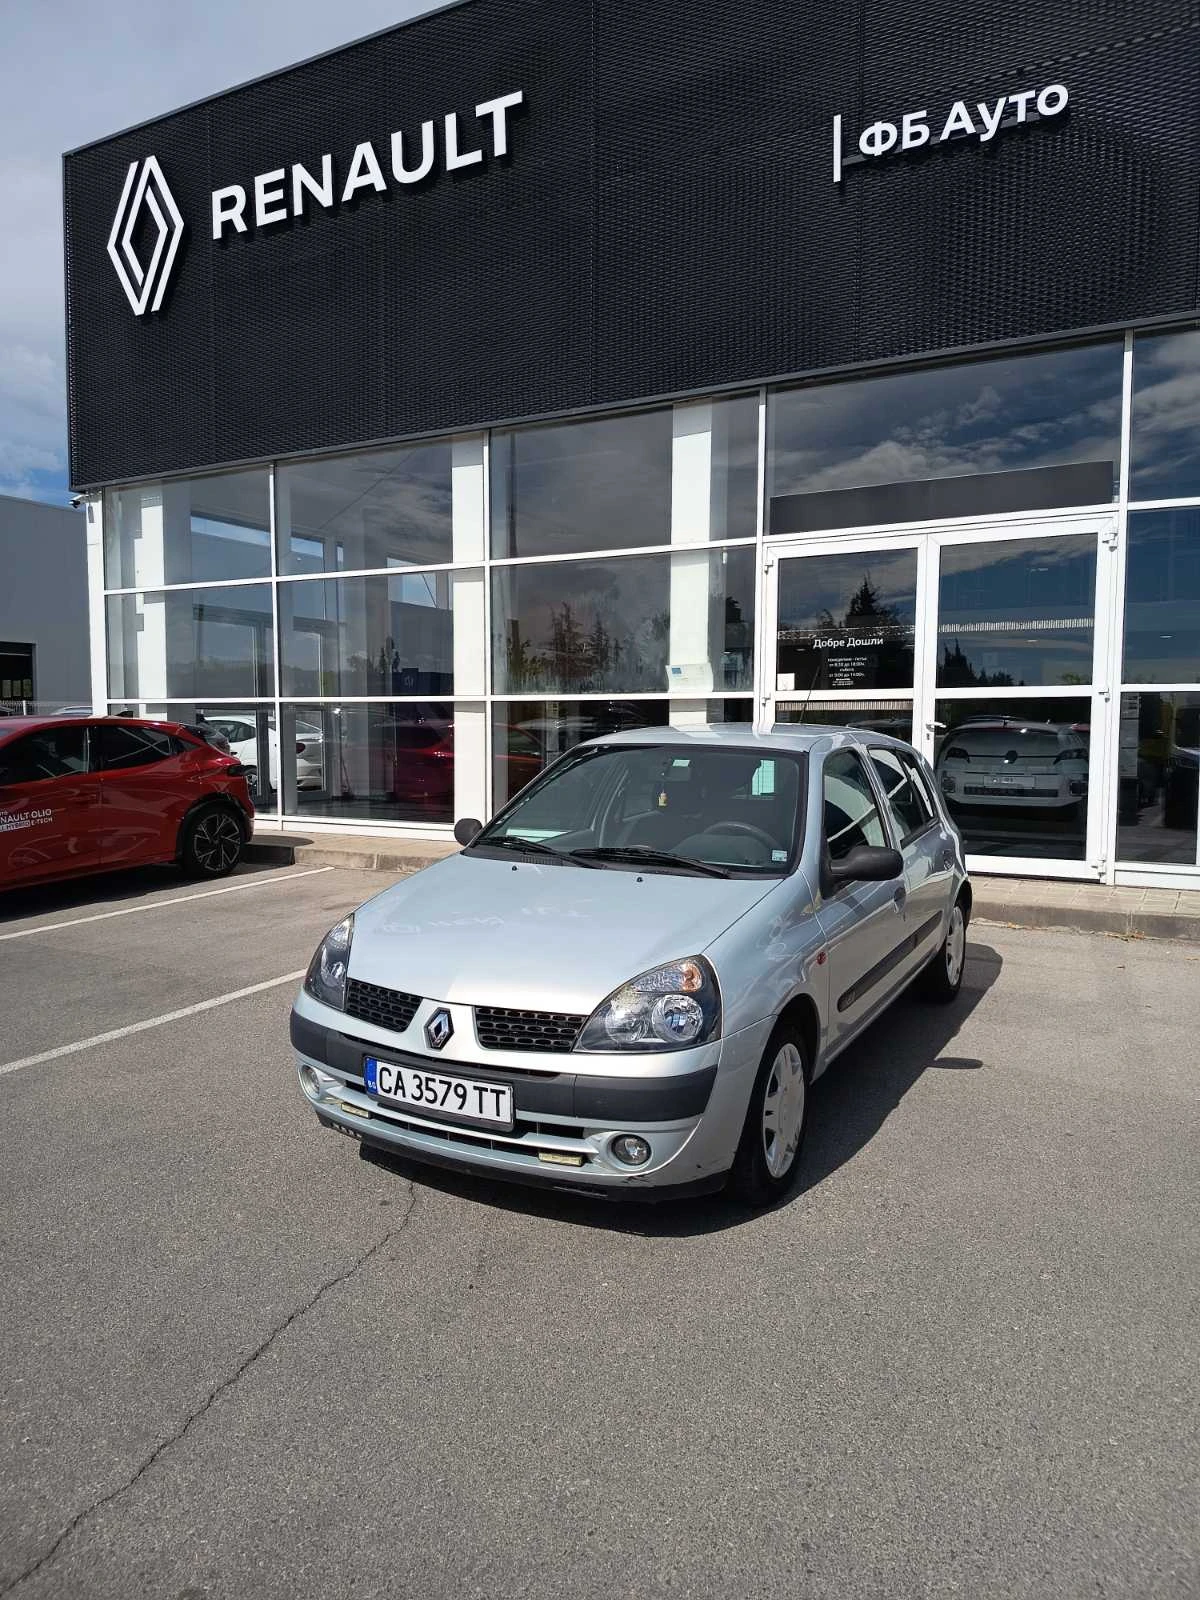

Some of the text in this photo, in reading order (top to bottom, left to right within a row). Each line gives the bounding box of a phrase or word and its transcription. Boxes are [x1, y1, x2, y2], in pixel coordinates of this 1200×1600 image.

[858, 84, 1069, 156] ФБ Ауто
[211, 90, 524, 240] RENAULT
[813, 637, 884, 649] Добре Дошли
[0, 812, 29, 823] NAULT
[379, 1066, 506, 1117] CA 3579 TT
